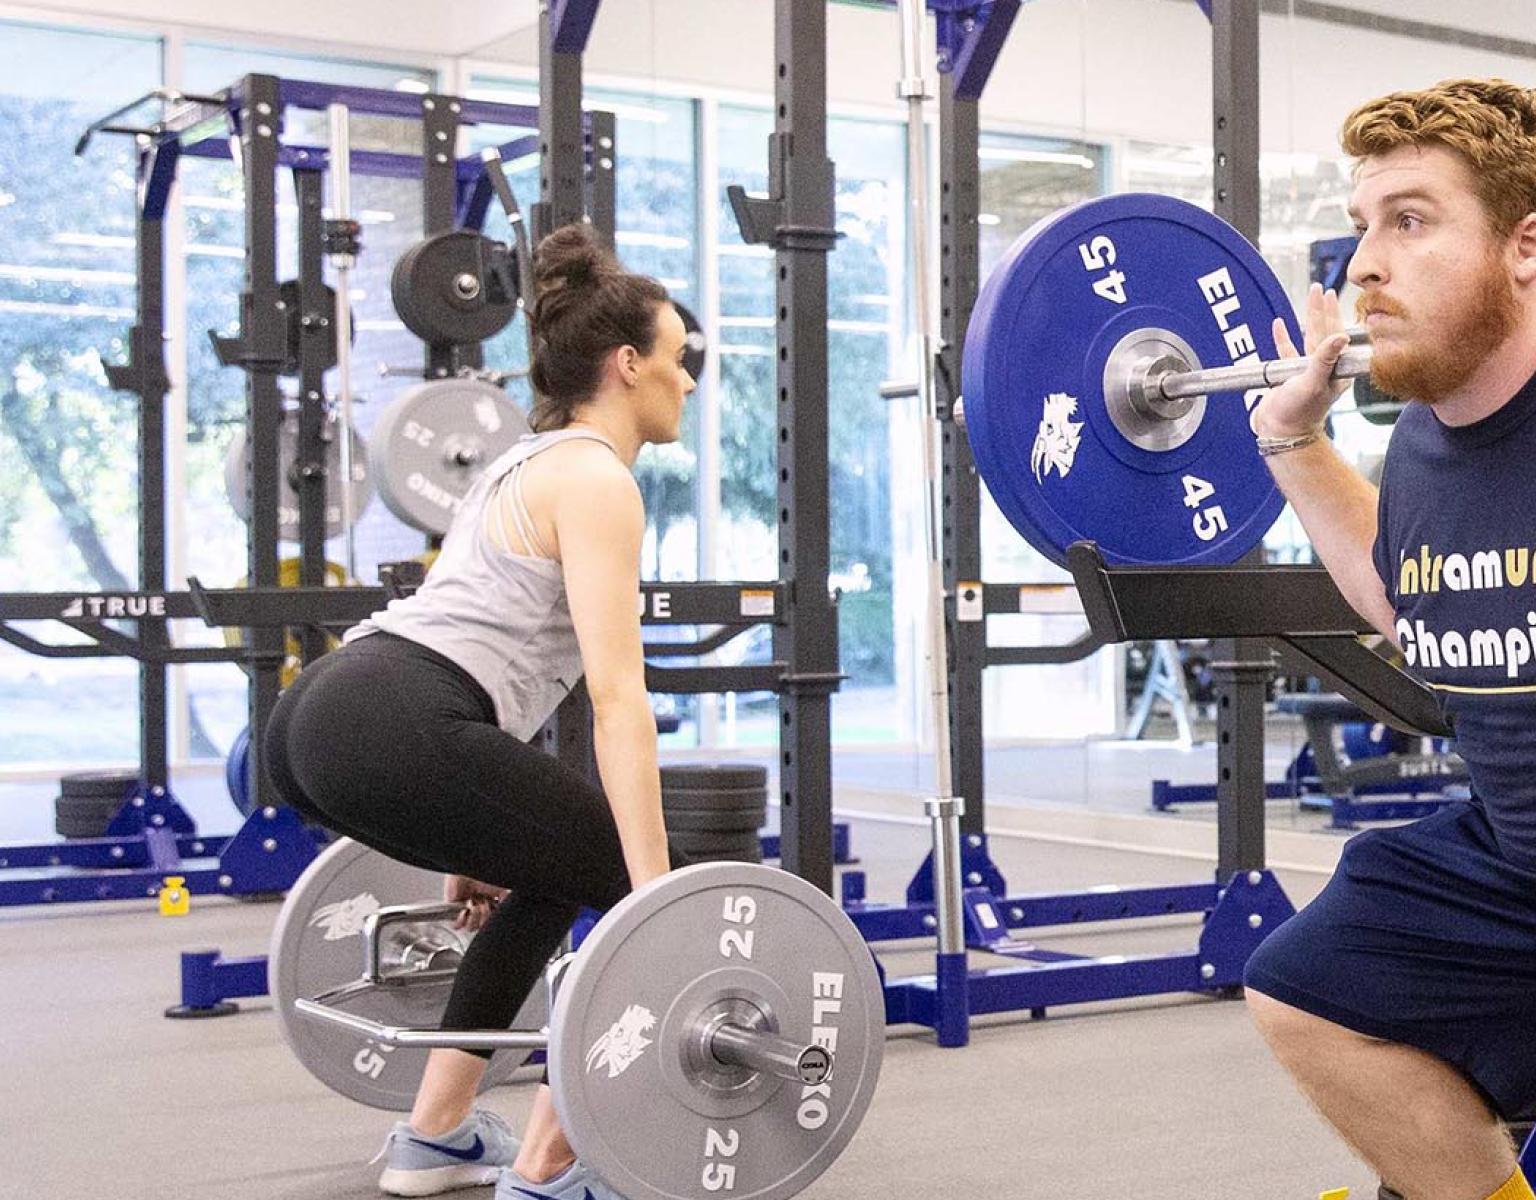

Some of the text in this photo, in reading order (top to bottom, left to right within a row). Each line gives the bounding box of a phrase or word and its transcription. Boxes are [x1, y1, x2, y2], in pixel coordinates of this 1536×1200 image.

[1079, 235, 1127, 304] 45
[1181, 474, 1229, 541] 45
[86, 596, 166, 617] TRUE
[719, 895, 757, 960] 25
[796, 971, 844, 1130] ELEKO
[702, 1128, 739, 1192] 25
